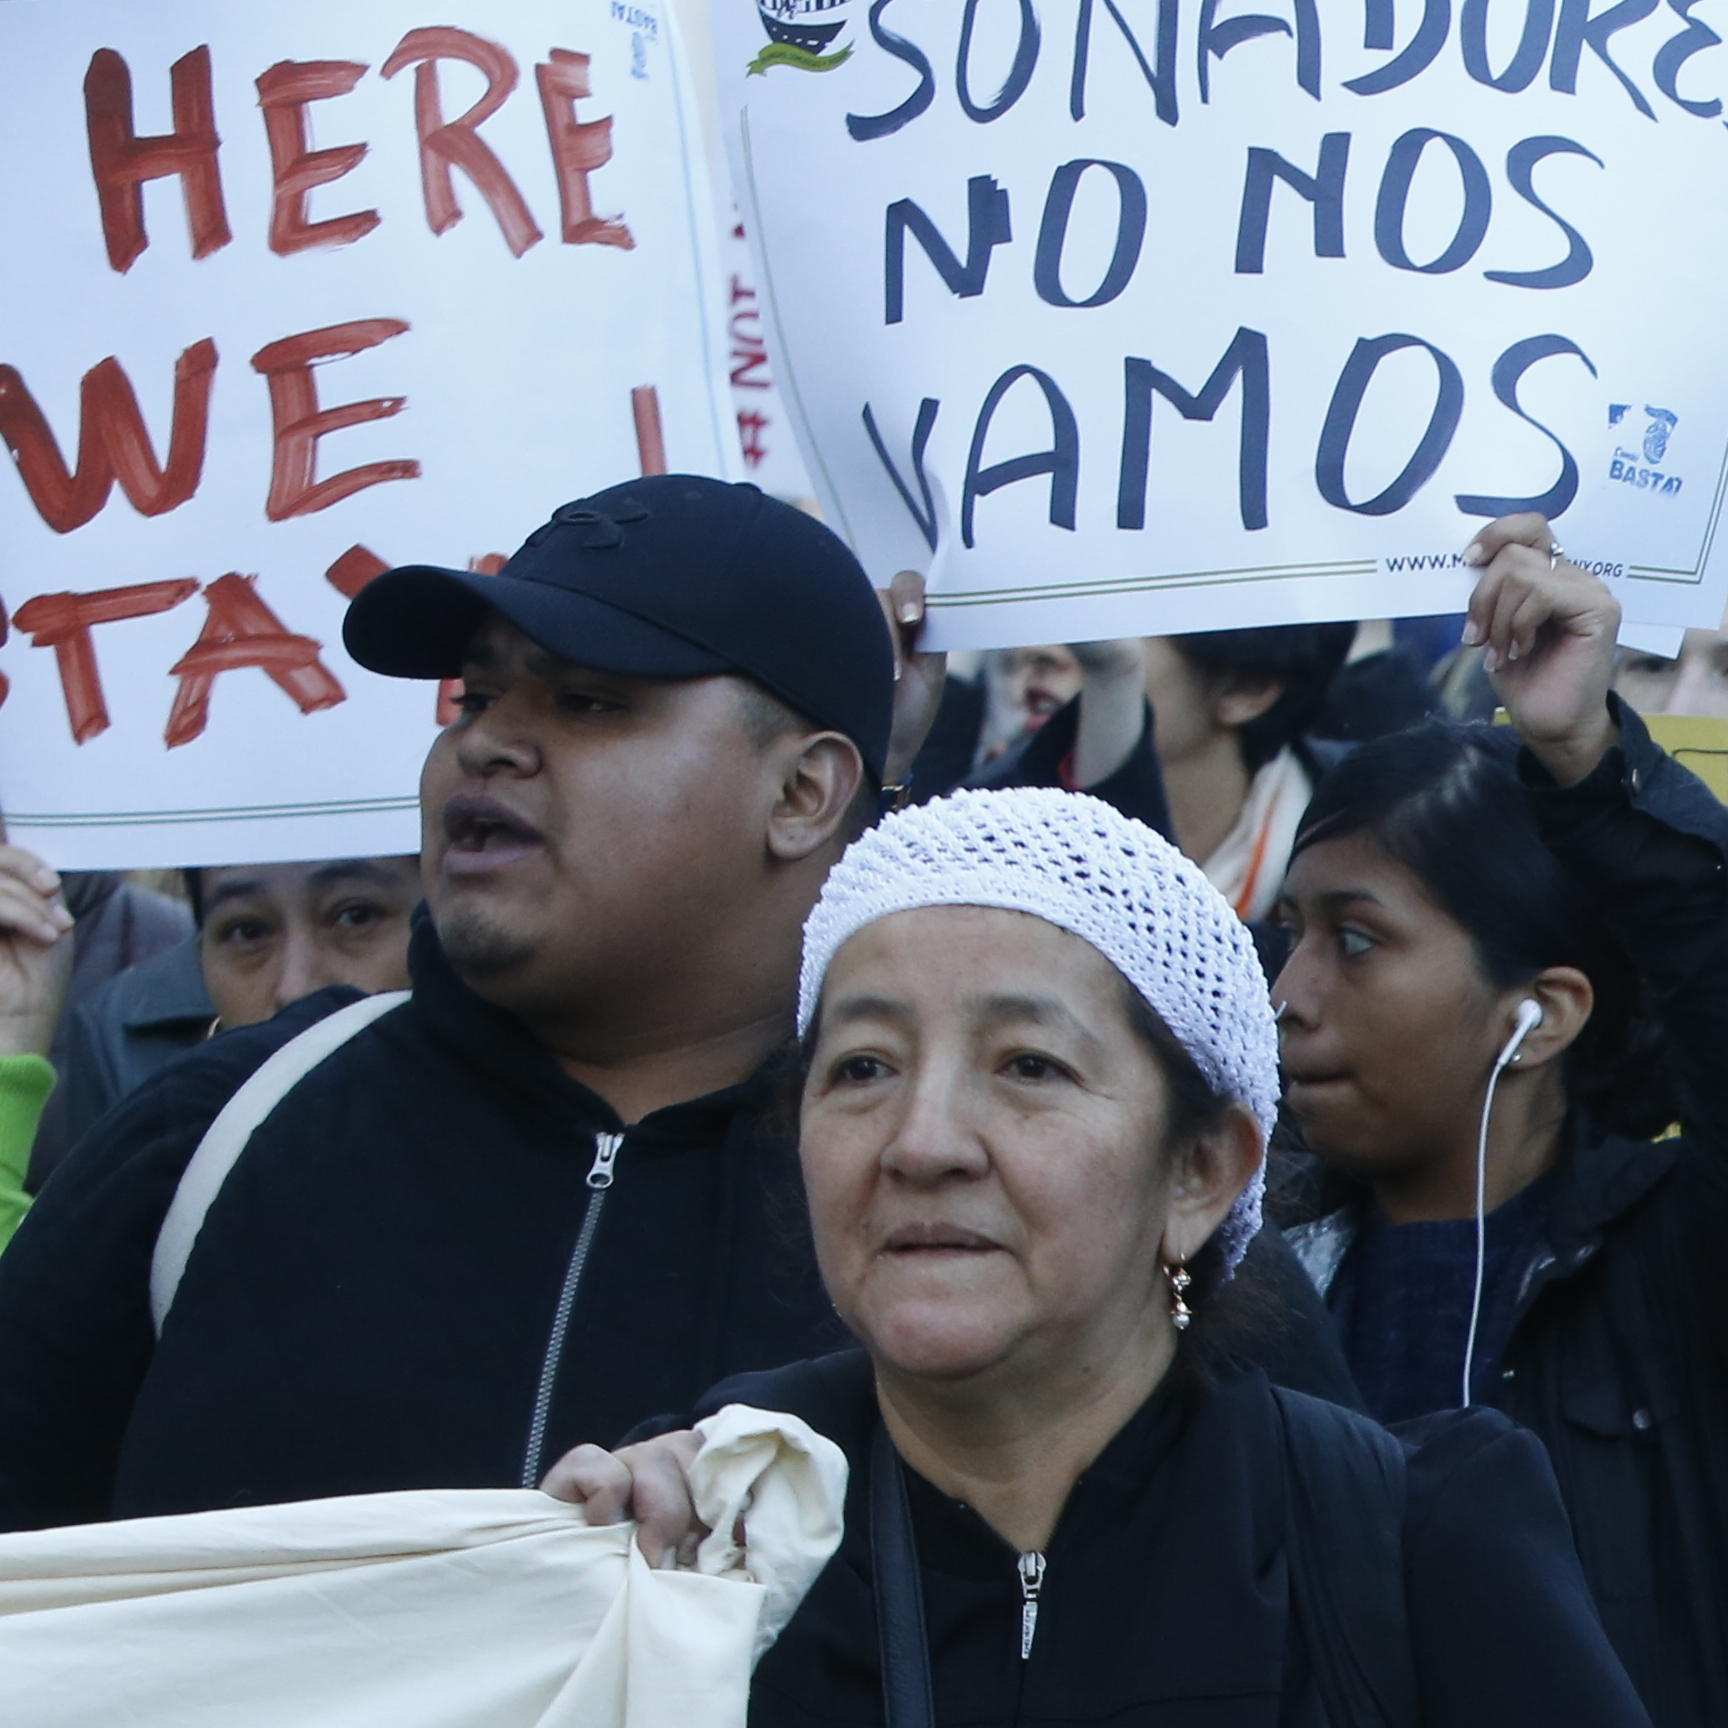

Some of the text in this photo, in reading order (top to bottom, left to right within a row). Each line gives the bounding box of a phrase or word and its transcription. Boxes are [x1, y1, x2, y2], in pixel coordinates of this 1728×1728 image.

[84, 25, 637, 273] HERE
[885, 126, 1604, 325] NO NOS
[0, 318, 422, 533] WE
[861, 326, 1598, 553] VAMOS
